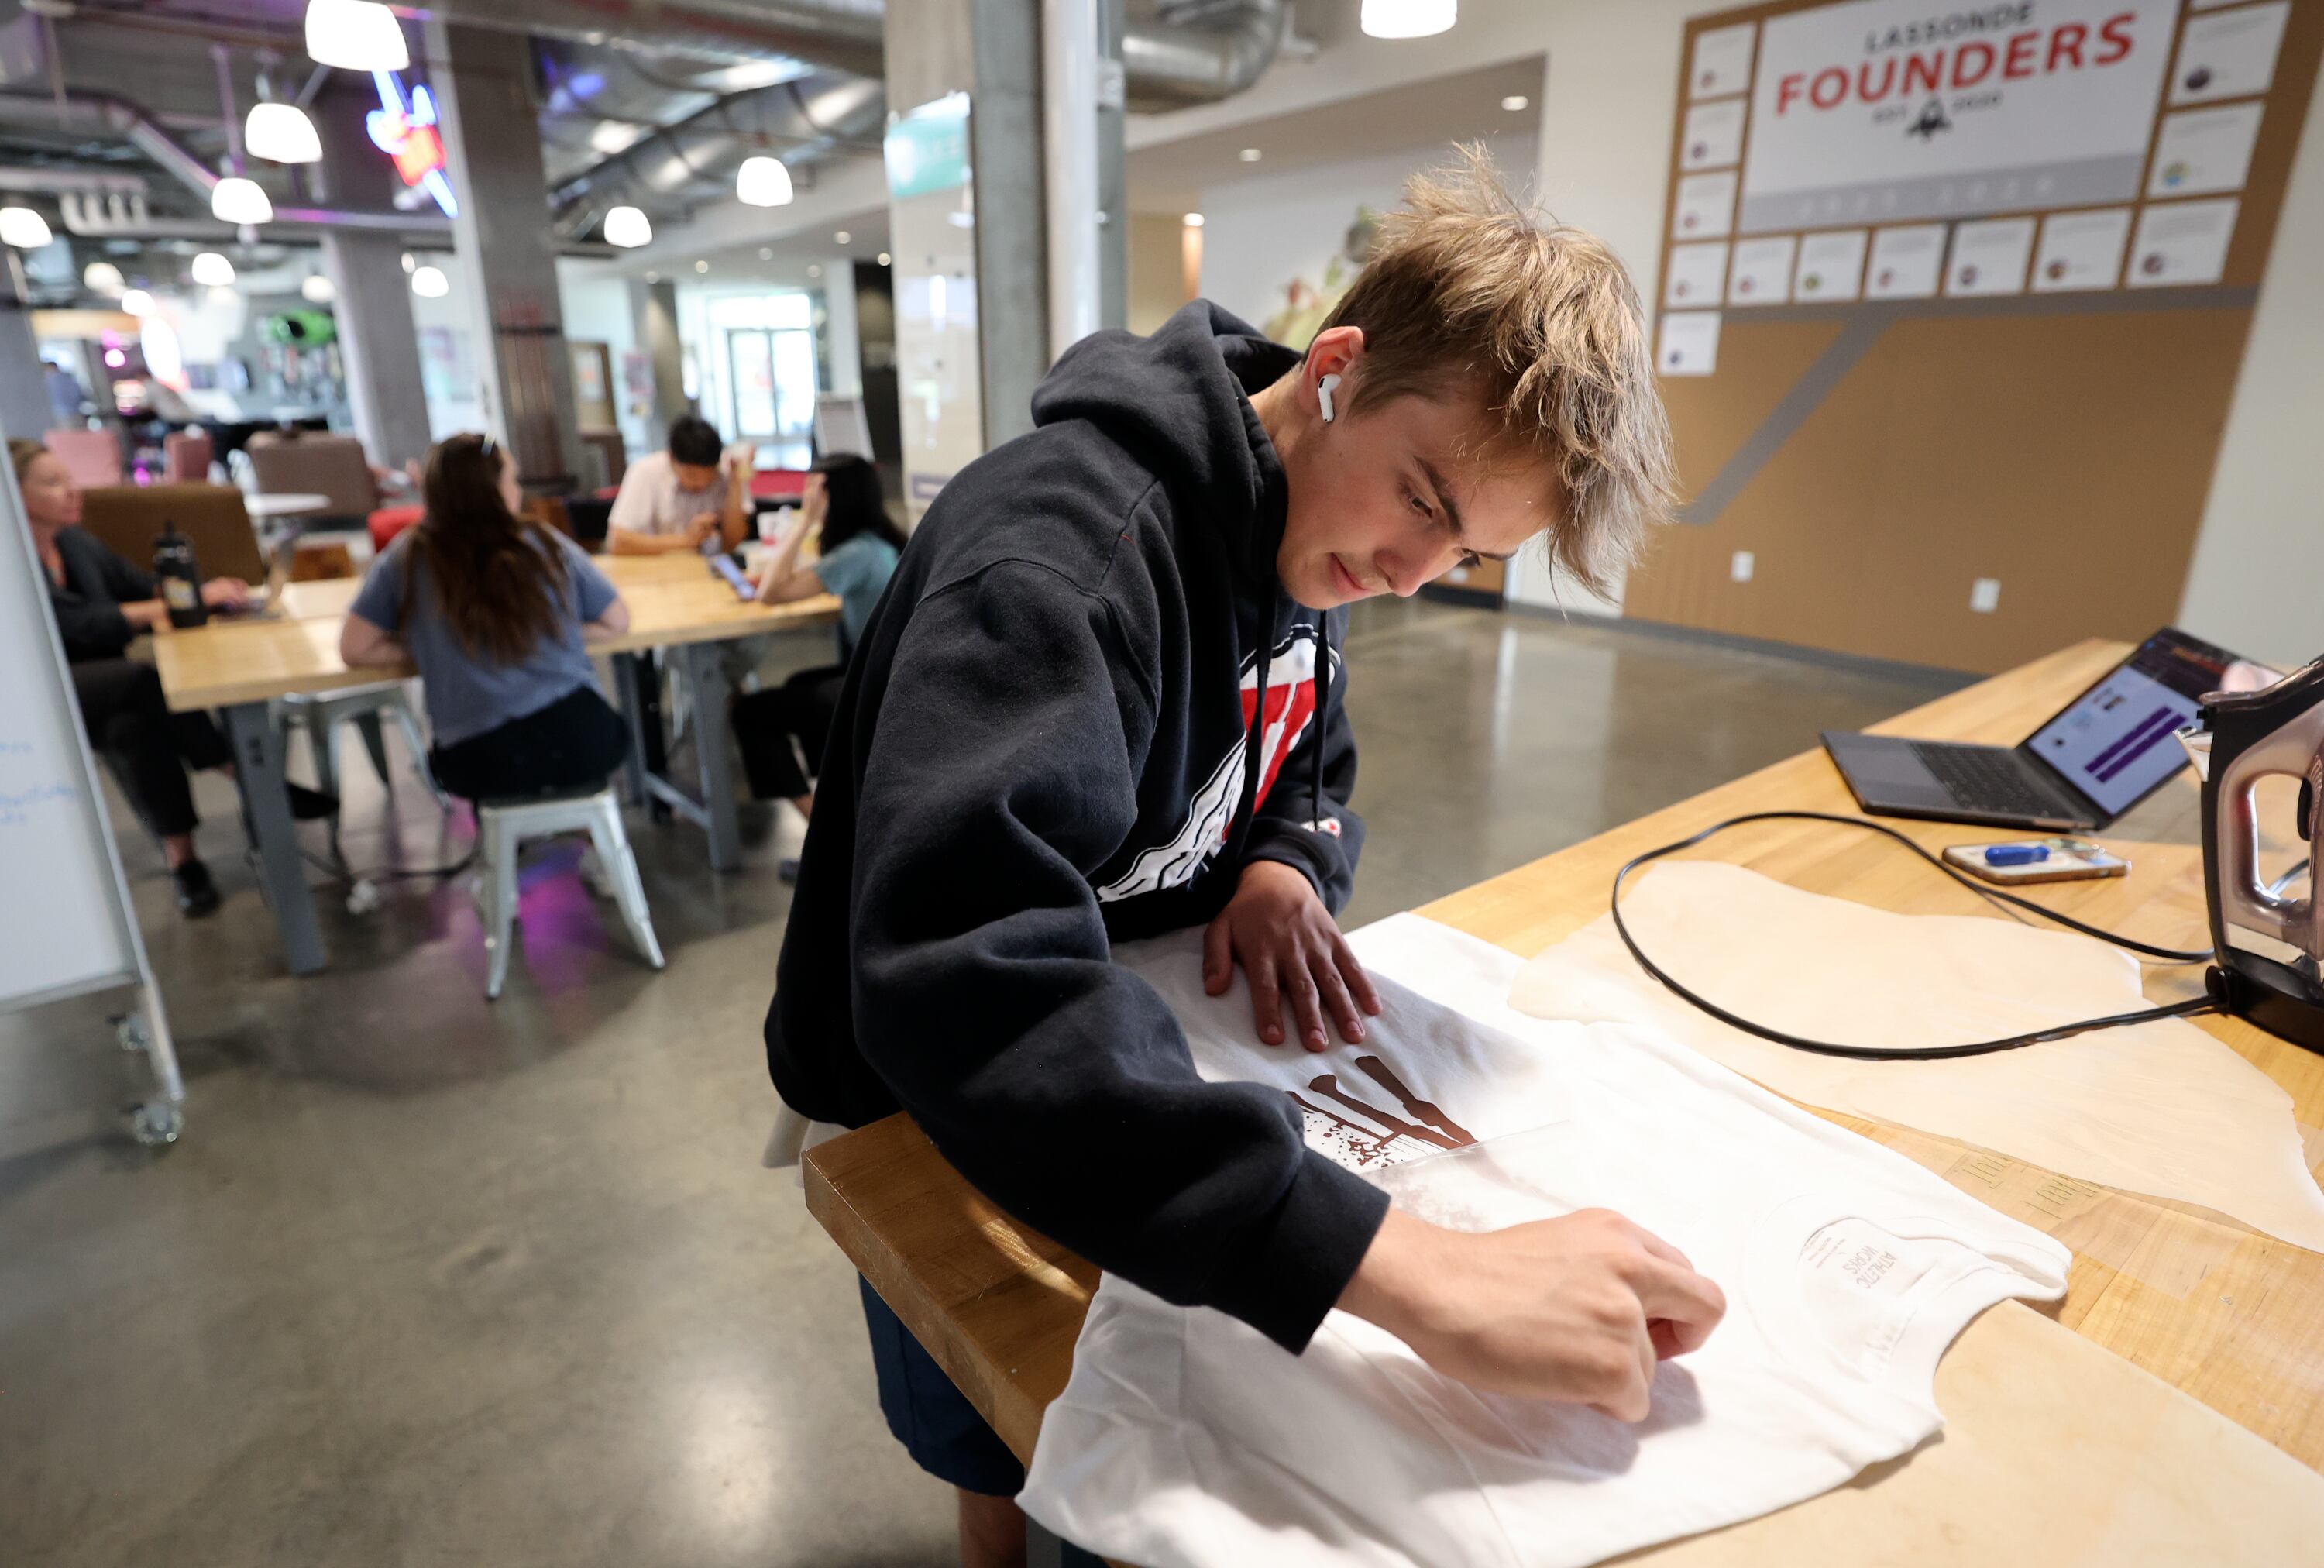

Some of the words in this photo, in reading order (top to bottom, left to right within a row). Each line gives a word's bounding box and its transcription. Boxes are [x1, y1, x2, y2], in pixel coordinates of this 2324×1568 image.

[1865, 1, 2034, 53] LASSONDE
[1776, 12, 2136, 116] FOUNDERS
[1841, 1245, 1880, 1275] WORKS
[1856, 1250, 1897, 1289] ATHLETIC
